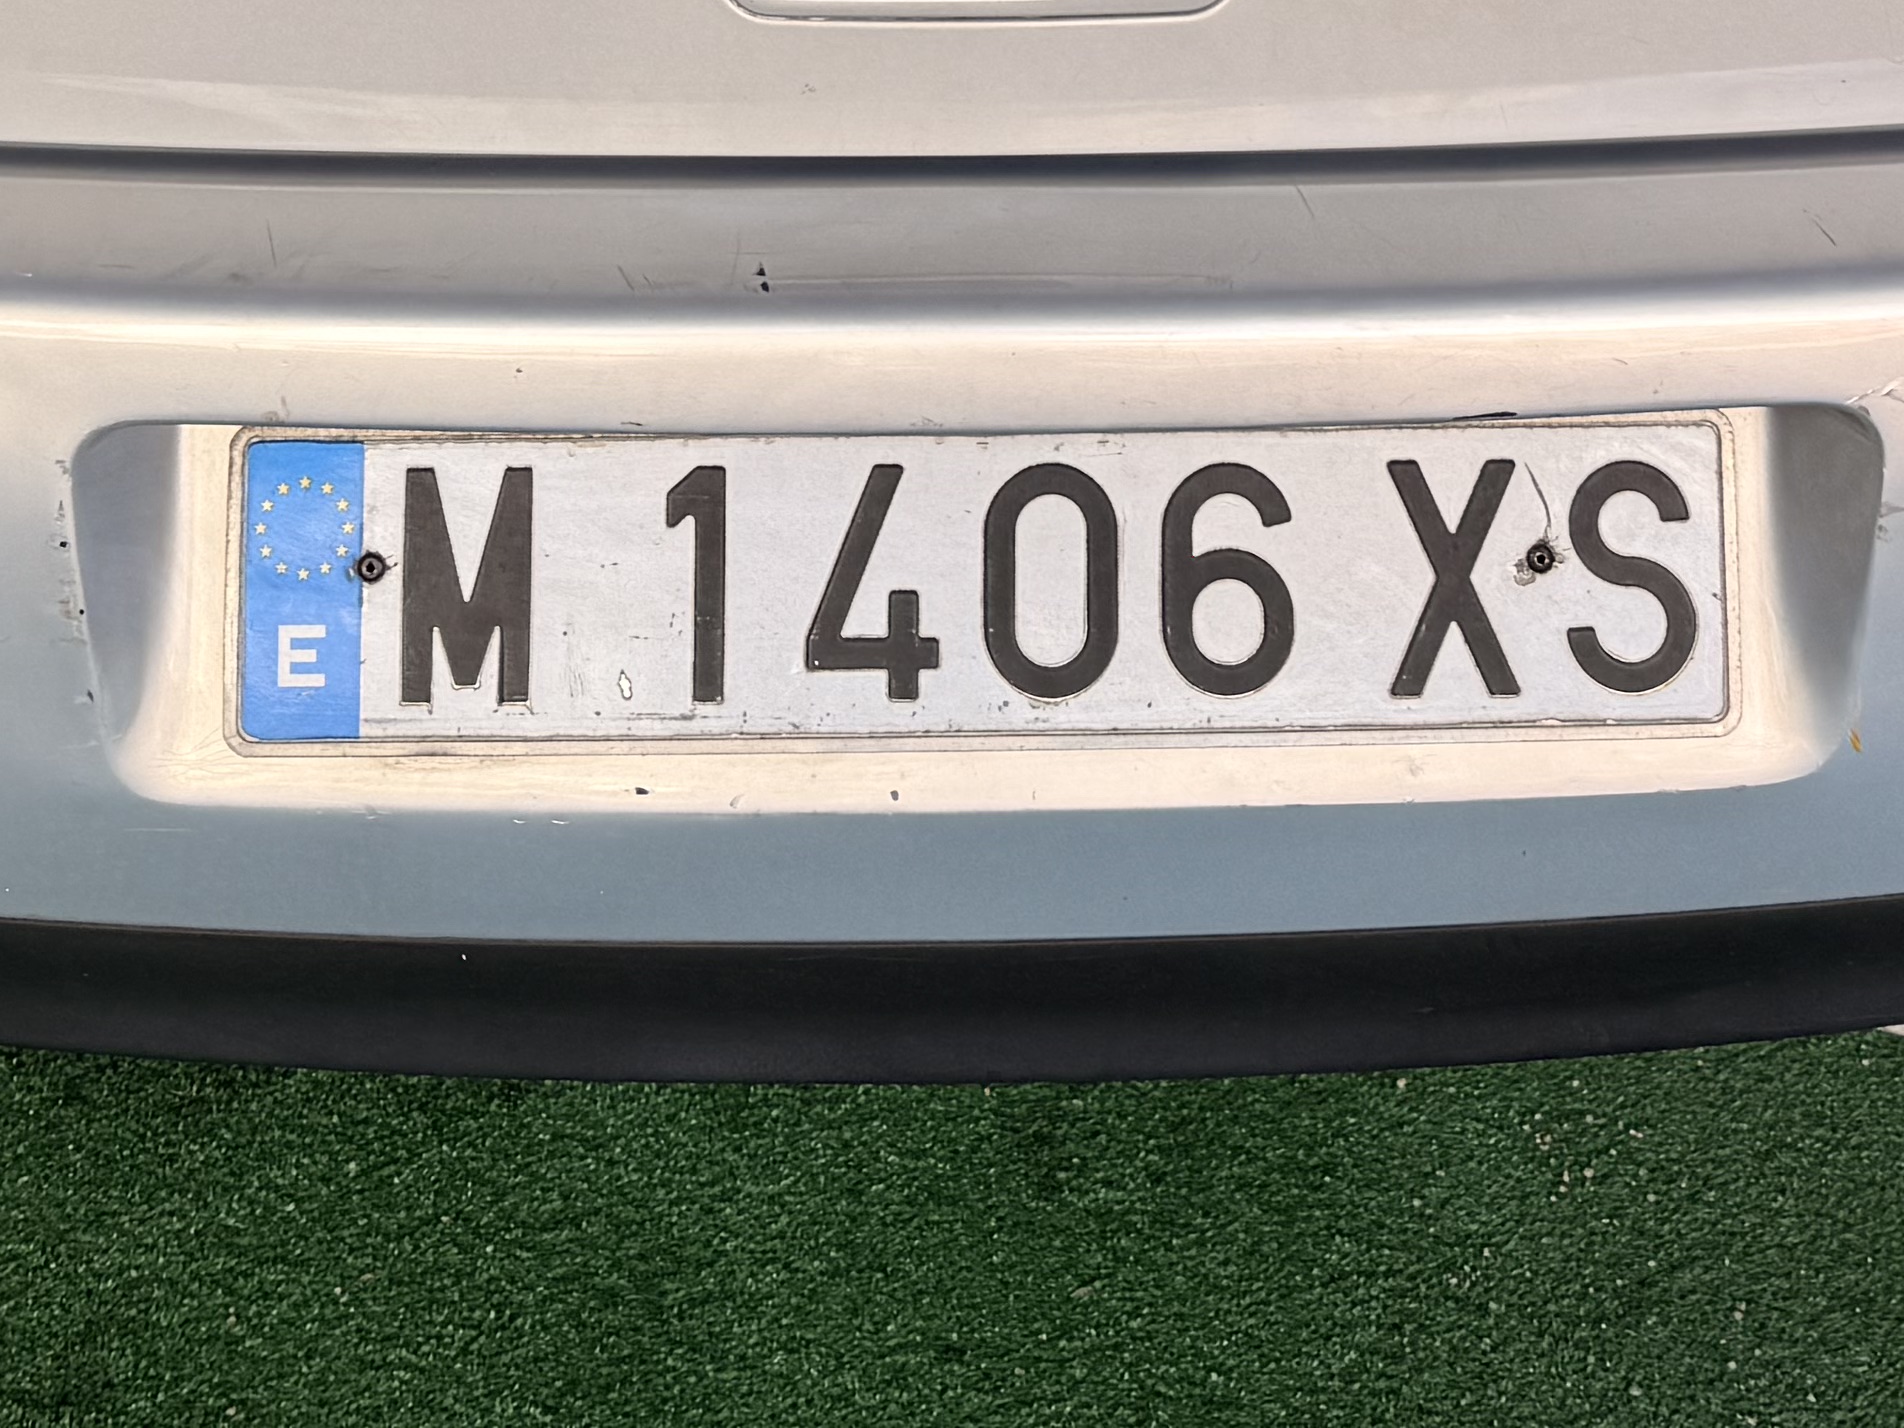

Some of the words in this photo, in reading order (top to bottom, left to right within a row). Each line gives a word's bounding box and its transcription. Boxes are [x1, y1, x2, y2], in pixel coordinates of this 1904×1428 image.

[274, 622, 326, 689] E
[400, 465, 532, 705] M
[663, 460, 1296, 705] 1406
[1387, 457, 1698, 700] XS
